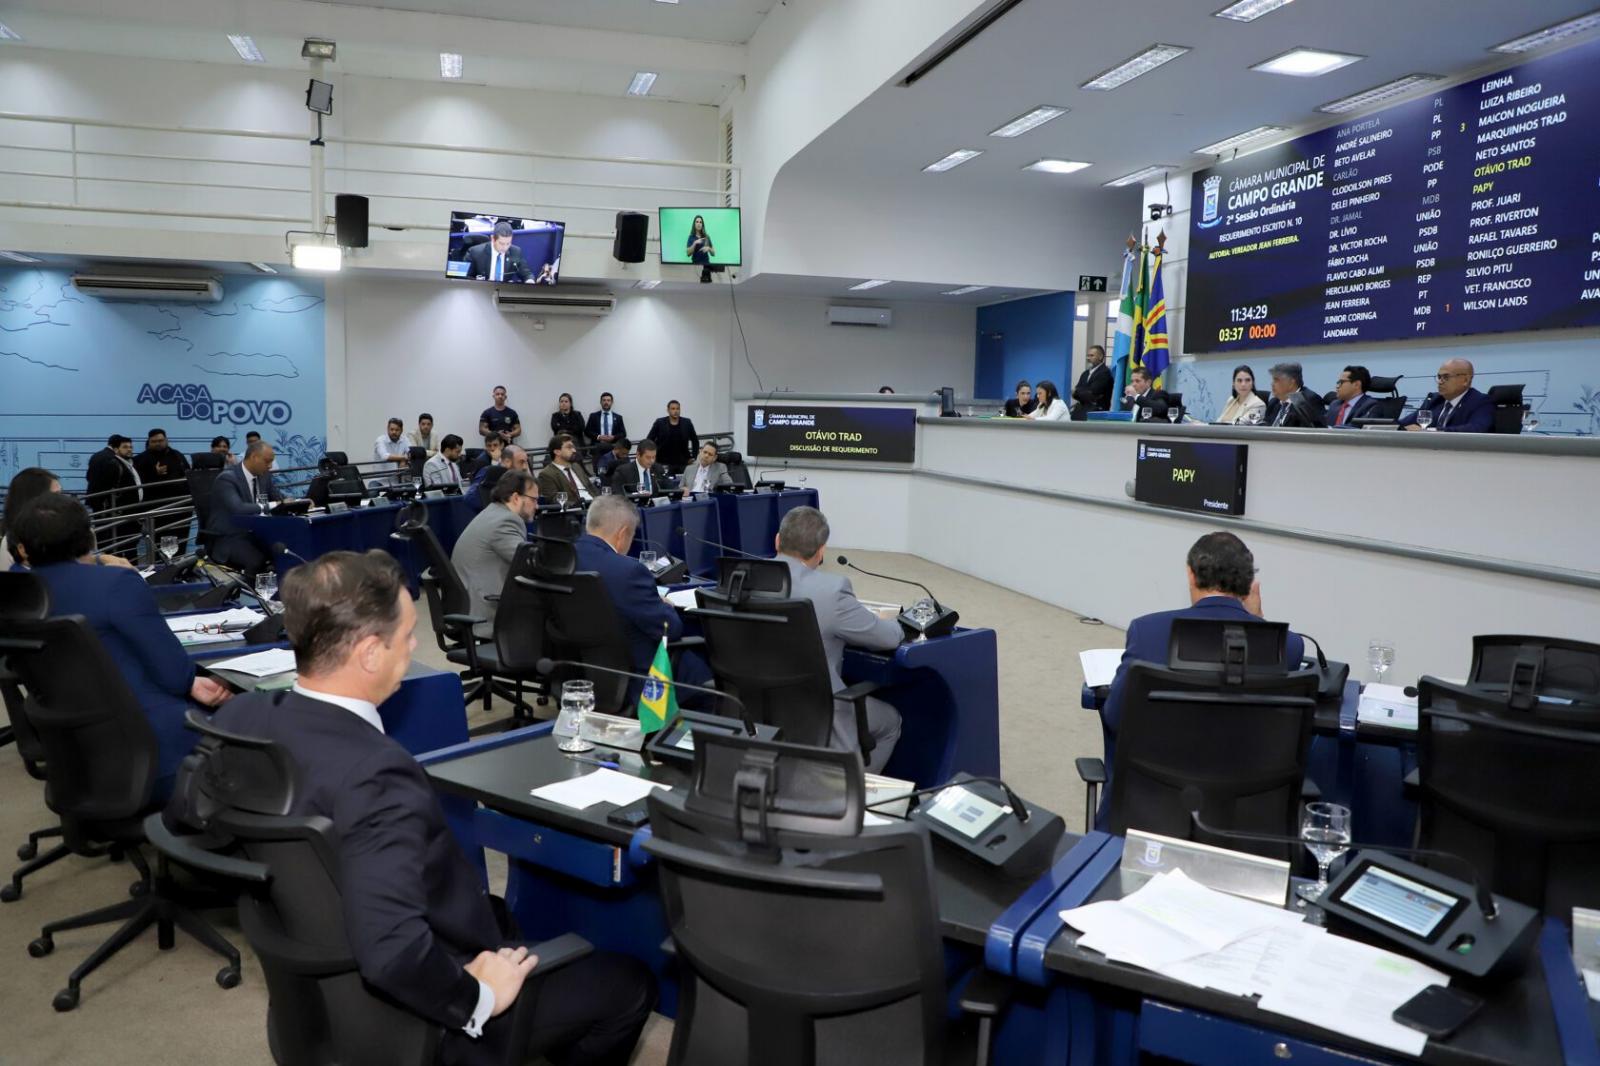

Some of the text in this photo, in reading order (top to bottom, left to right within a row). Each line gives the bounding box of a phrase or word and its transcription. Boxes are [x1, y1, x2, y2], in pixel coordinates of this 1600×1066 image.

[1481, 75, 1514, 93] LEINHA
[1434, 98, 1443, 108] PL
[1480, 83, 1541, 110] LUIZA RIBEIRO
[1478, 94, 1566, 127] MAICON NOGUEIRA
[1433, 114, 1442, 124] PL
[1337, 118, 1380, 139] ANA PORTELA
[1460, 122, 1465, 132] 3
[1477, 111, 1567, 144] MARQUINHOS TRAD
[1431, 130, 1441, 140] PP
[1335, 136, 1357, 153] ANDRÉ
[1428, 146, 1442, 157] PSB
[1475, 137, 1536, 161] NETO SANTOS
[1334, 148, 1376, 168] BETO AVELAR
[1229, 154, 1325, 193] CÂMARA MUNICIPAL DE
[1333, 167, 1358, 181] CARLÃO
[1423, 161, 1444, 174] PODE
[1473, 156, 1532, 178] OTÁVIO TRAD
[1374, 174, 1392, 185] PIRES
[1427, 178, 1437, 188] PP
[1228, 171, 1324, 210] CAMPO GRANDE
[1472, 181, 1494, 195] PAPY
[1331, 192, 1380, 211] DELEI PINHEIRO
[1422, 194, 1440, 205] MDB
[1471, 192, 1521, 211] PROF. JUARI
[1235, 208, 1258, 223] Sessão
[1260, 200, 1296, 216] Ordinária
[1342, 211, 1363, 222] JAMAL
[1416, 209, 1441, 222] UNIÃO
[1469, 206, 1540, 228] PROF. RIVERTON
[1219, 226, 1261, 242] REQUERIMENTO
[1262, 220, 1286, 233] ESCRITO
[1295, 216, 1303, 225] 10
[1329, 226, 1357, 239] DR. LÍVIO
[1419, 225, 1438, 237] PSDB
[1468, 224, 1538, 245] RAFAEL TAVARES
[1231, 243, 1258, 255] VEREADOR
[1258, 240, 1271, 249] JEAN
[1328, 235, 1388, 254] DR. VICTOR ROCHA
[1413, 241, 1438, 254] UNIÃO
[1467, 239, 1557, 262] RONILÇO GUERREIRO
[1327, 253, 1369, 268] FÁBIO ROCHA
[1416, 257, 1435, 269] PSDB
[1326, 265, 1385, 282] FLAVIO CABO ALMI
[1465, 263, 1513, 278] SILVIO PITU
[1417, 274, 1432, 284] REP
[1464, 278, 1532, 294] VET. FRANCISCO
[1325, 279, 1391, 296] HERCULANO BORGES
[1418, 290, 1428, 300] PT
[1324, 297, 1370, 310] JEAN FERREIRA
[1413, 305, 1431, 316] MDB
[1463, 296, 1528, 311] WILSON LANDS
[1231, 304, 1268, 322] 11:34:29
[1323, 311, 1377, 325] JUNIOR CORINGA
[1219, 323, 1276, 342] 03:37 00:00
[1323, 327, 1358, 338] LANDMARK
[1416, 321, 1426, 331] PT
[805, 429, 862, 442] OTÁVIO TRAD
[789, 443, 821, 452] DISCUSSÃO
[831, 446, 878, 454] REQUERIMENTO
[1172, 468, 1195, 483] PAPY
[1203, 498, 1229, 510] Presidente
